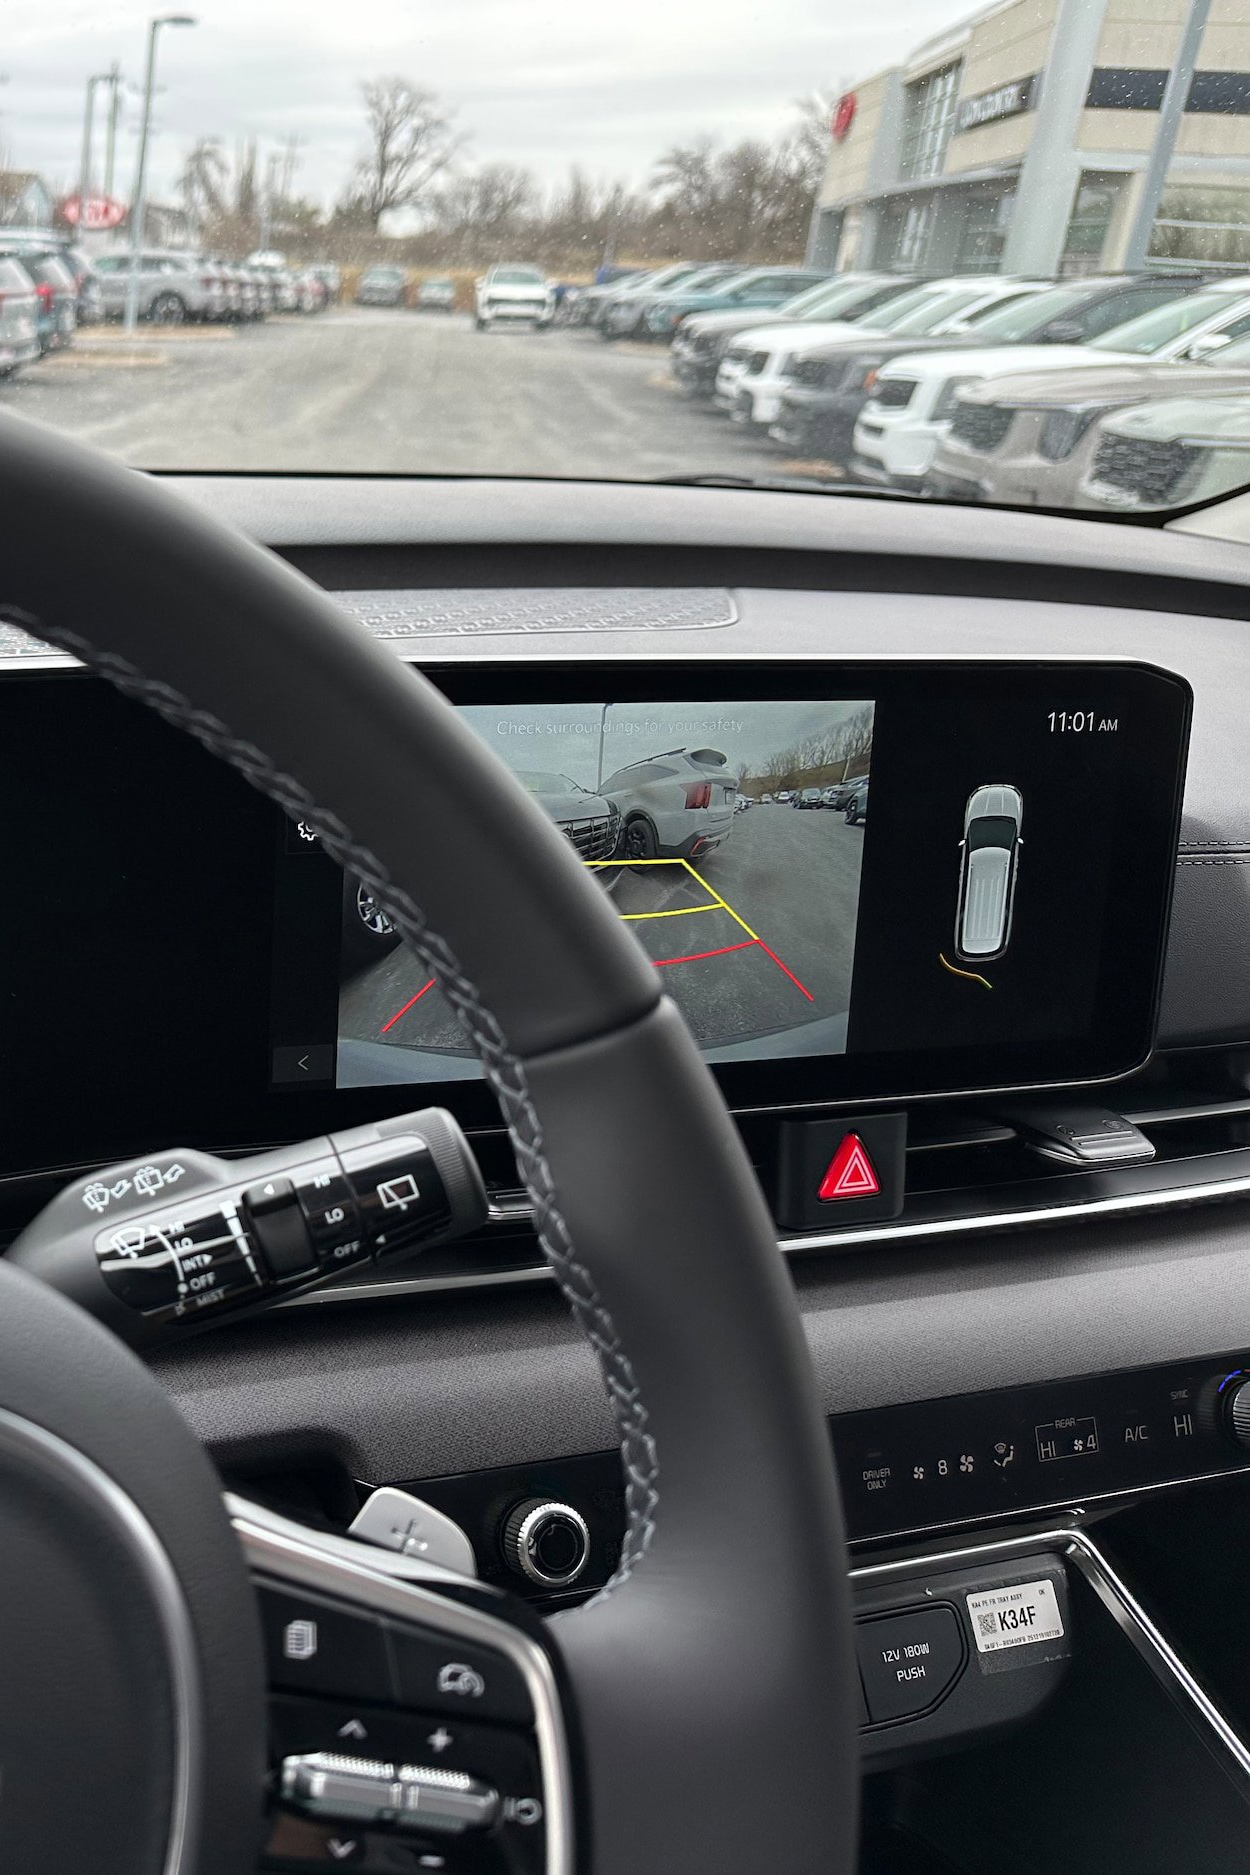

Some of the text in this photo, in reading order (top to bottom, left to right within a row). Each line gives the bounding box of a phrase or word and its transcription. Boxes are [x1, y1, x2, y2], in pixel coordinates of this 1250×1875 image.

[496, 718, 743, 735] Check surroundings for your safety
[1048, 711, 1119, 732] 11:01 AM
[325, 1207, 345, 1225] LO
[174, 1237, 193, 1253] LO
[334, 1241, 360, 1259] OFF
[182, 1254, 204, 1273] INT
[190, 1271, 216, 1291] OFF
[197, 1289, 225, 1307] MIST
[1170, 1389, 1189, 1400] SYNC
[1054, 1417, 1076, 1429] REAR
[1173, 1414, 1193, 1437] HI
[1086, 1434, 1096, 1450] 4
[1124, 1425, 1149, 1442] A/C
[1040, 1441, 1057, 1459] HI
[862, 1467, 891, 1481] DRIVER
[937, 1459, 948, 1476] 8
[867, 1479, 887, 1491] ONLY
[997, 1605, 1036, 1631] K34F
[882, 1642, 930, 1663] 12V 180W
[896, 1665, 926, 1682] PUSH
